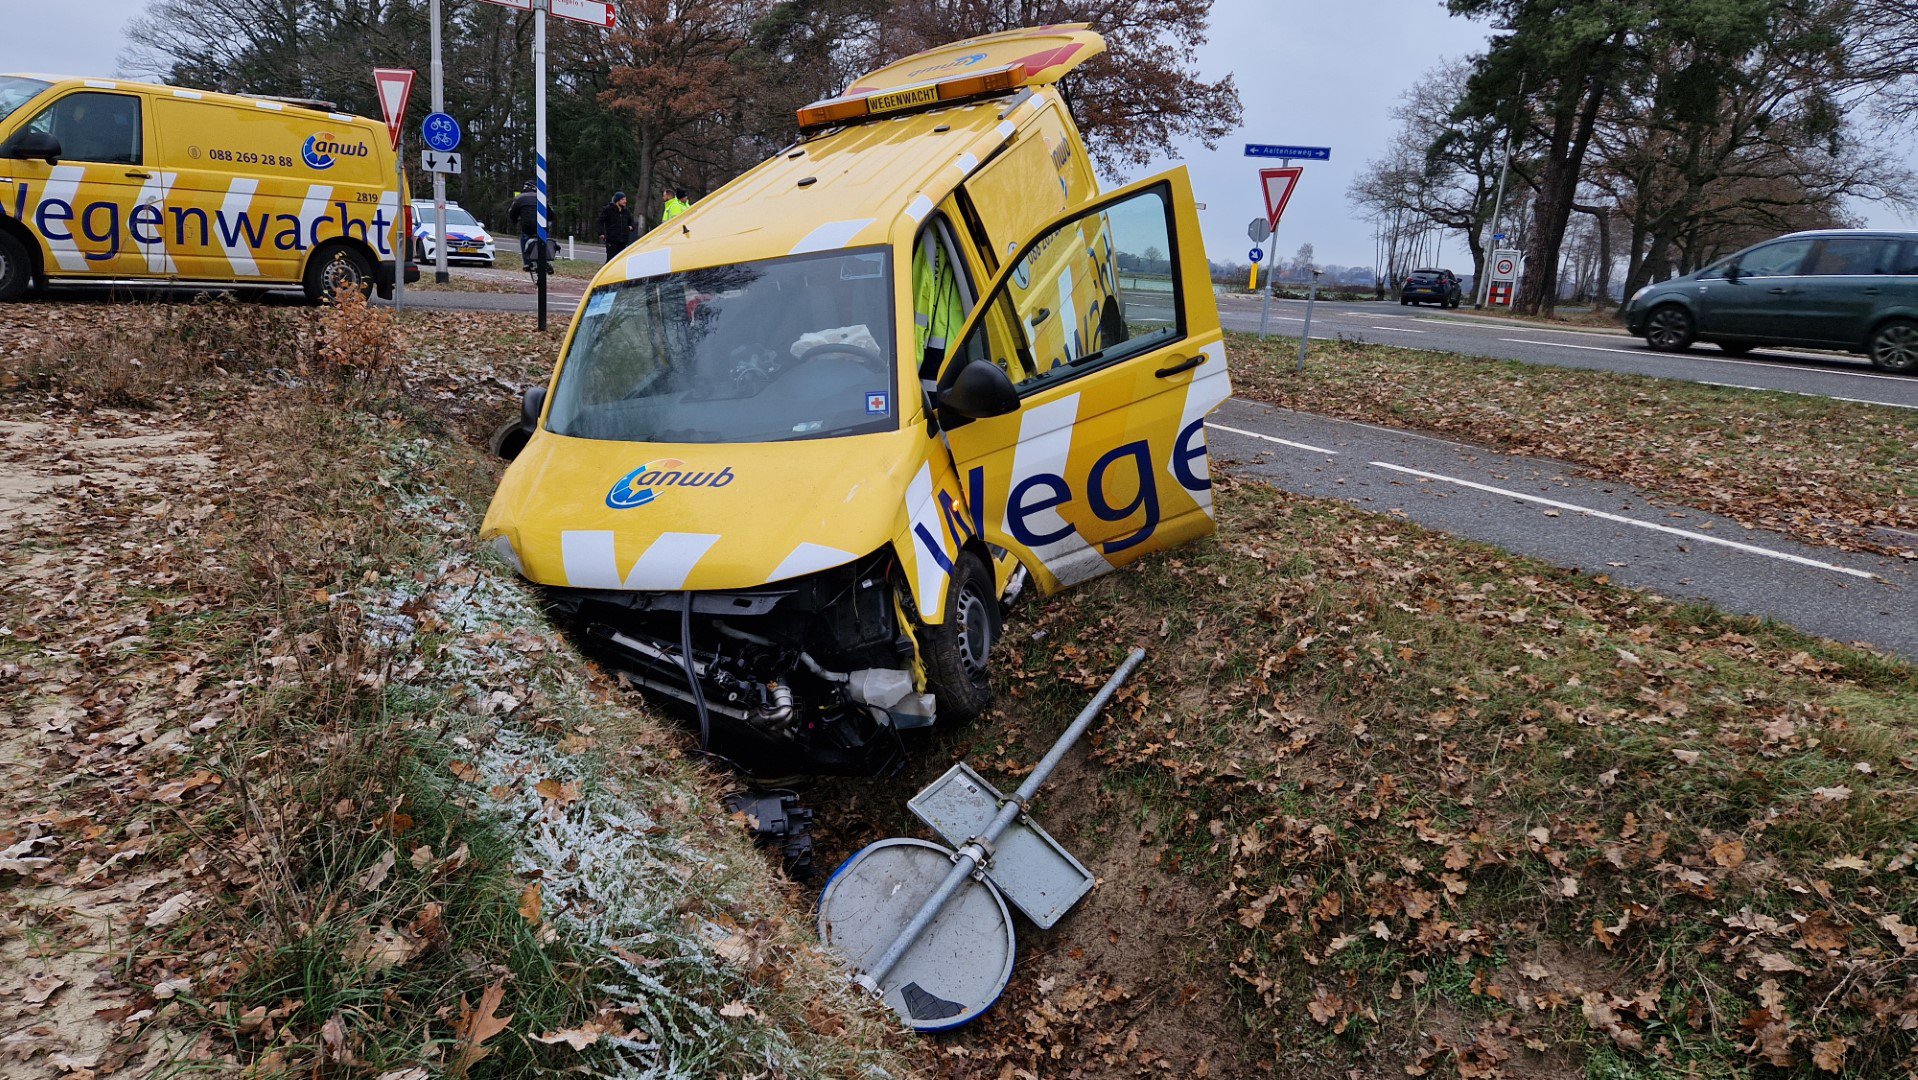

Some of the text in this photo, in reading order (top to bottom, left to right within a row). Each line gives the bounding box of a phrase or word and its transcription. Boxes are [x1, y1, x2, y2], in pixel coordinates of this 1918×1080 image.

[907, 60, 968, 78] anwb
[869, 87, 936, 111] WEGENWACHT
[315, 140, 368, 157] anwb
[1263, 146, 1312, 157] Aaltenseweg
[209, 149, 293, 167] 088 269 28 88
[356, 192, 379, 203] 2819
[0, 182, 392, 261] egenwacht
[636, 467, 735, 487] anwb
